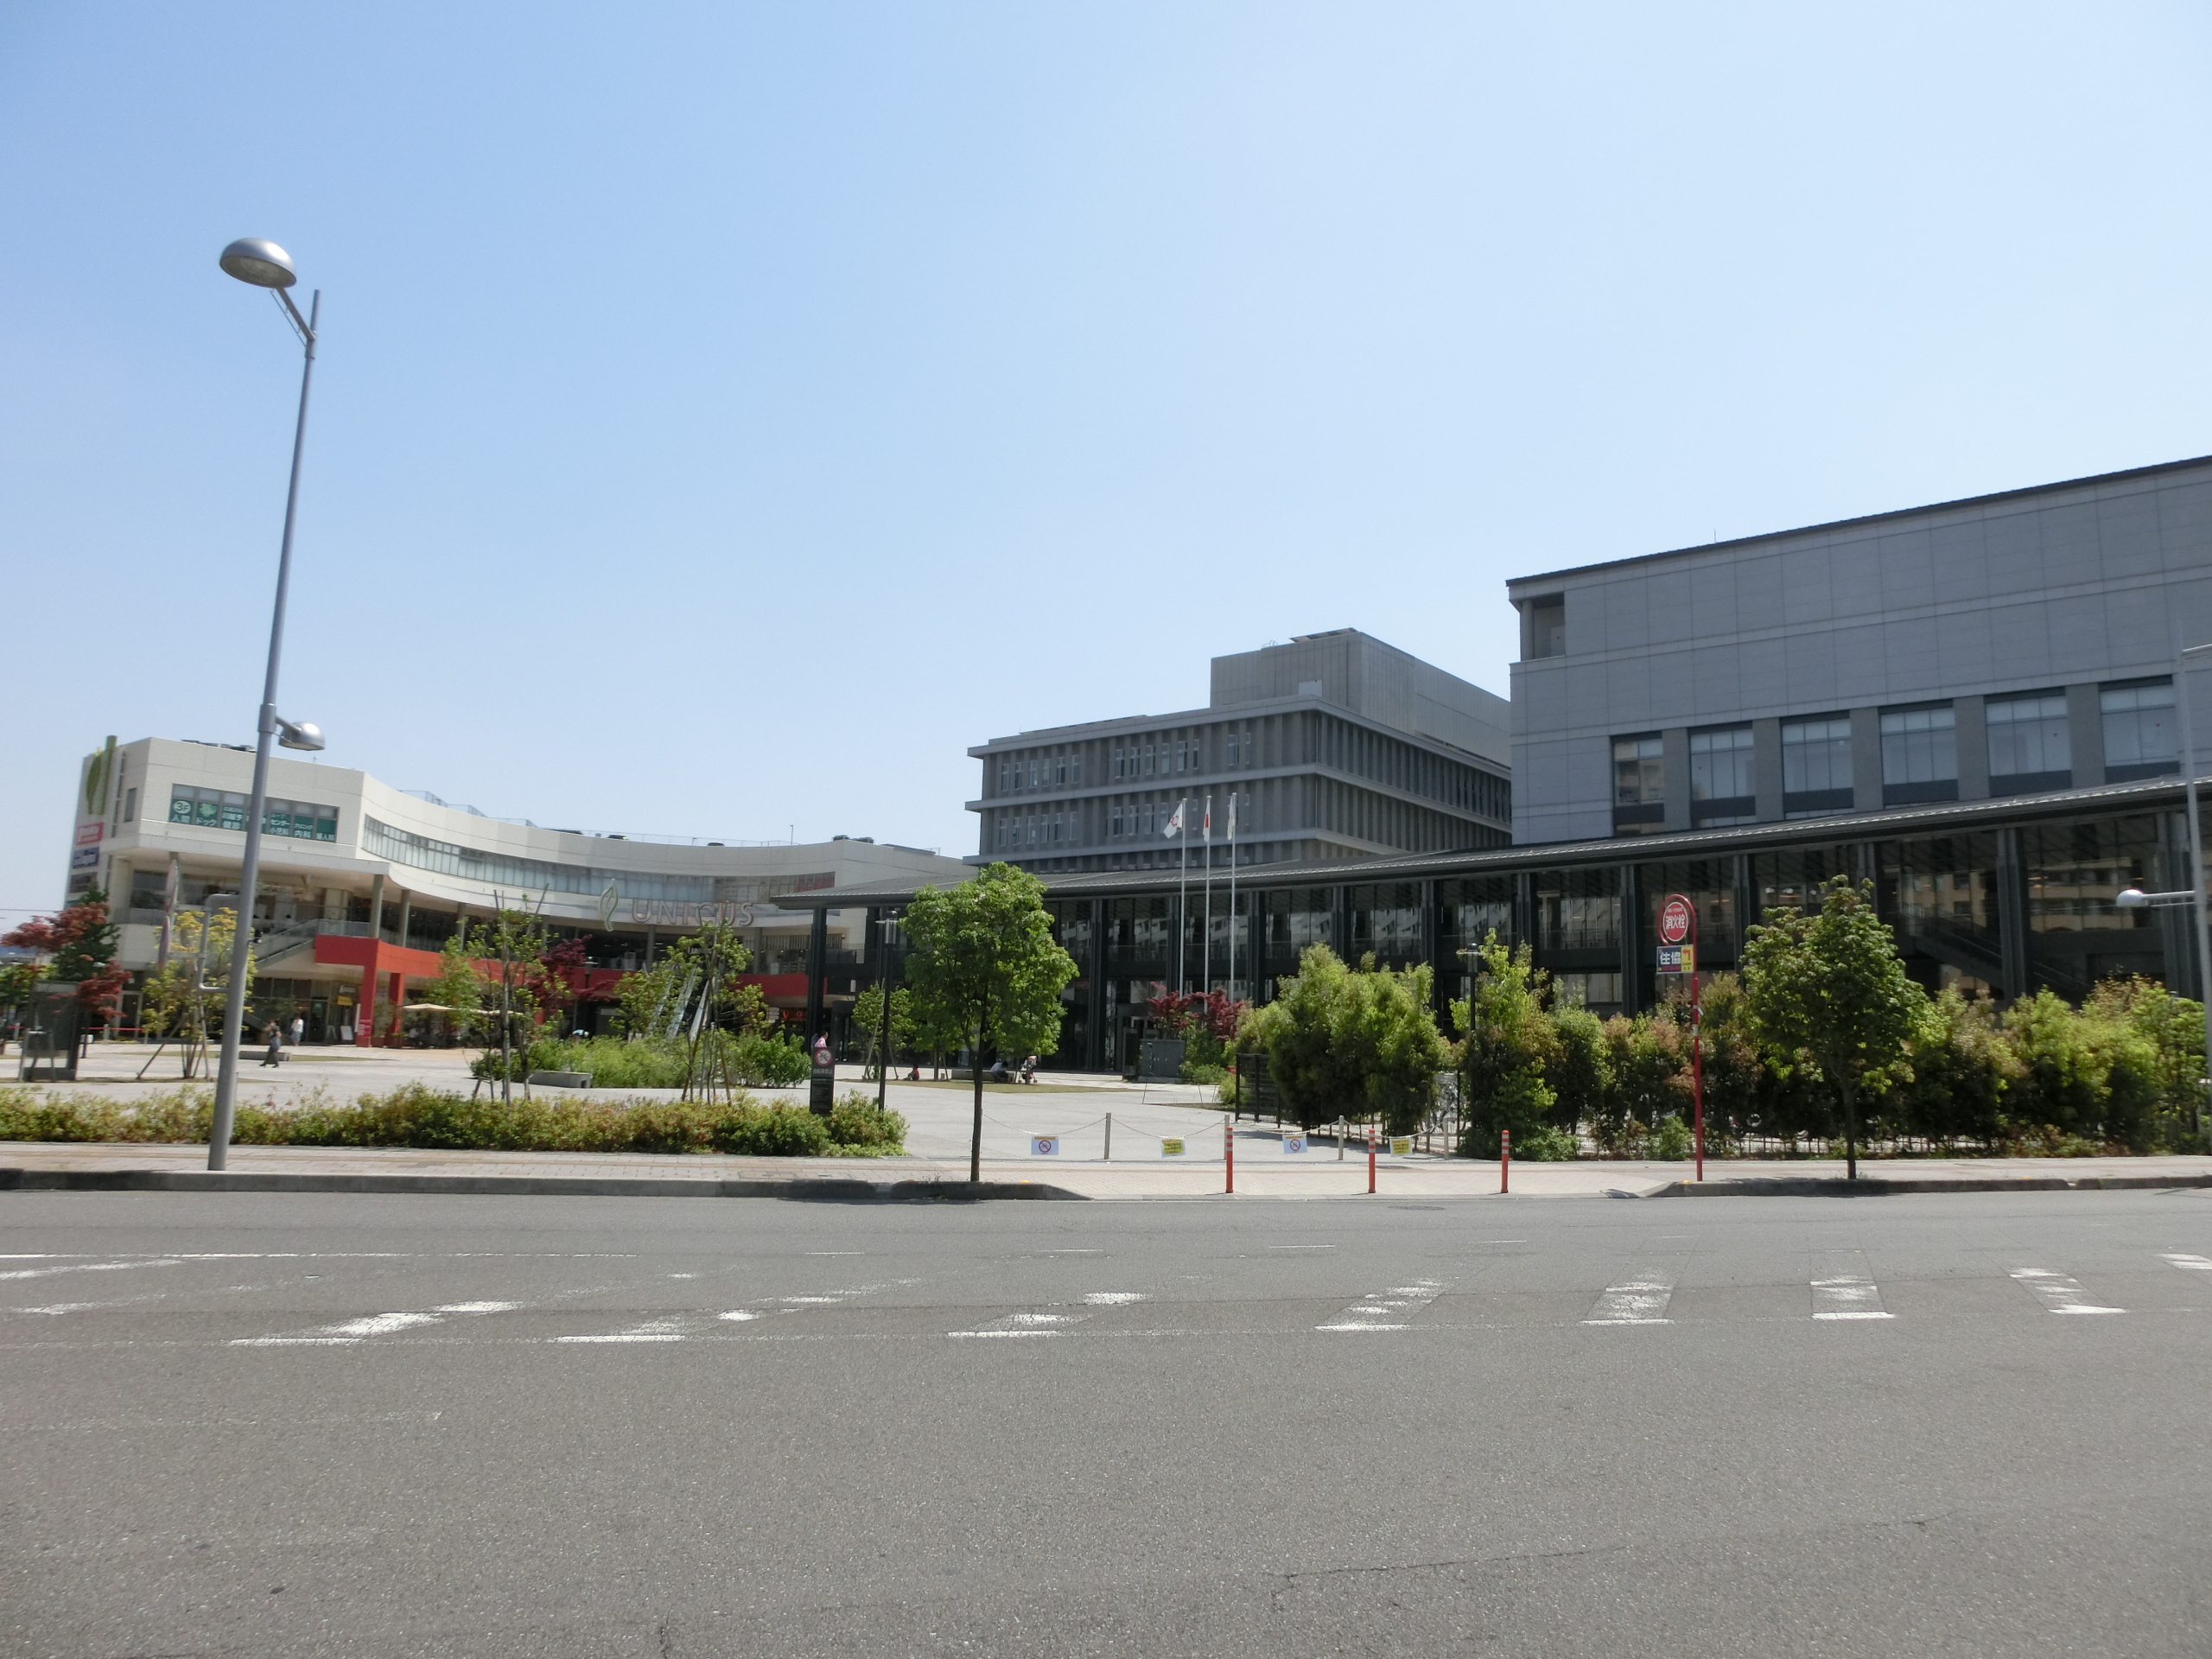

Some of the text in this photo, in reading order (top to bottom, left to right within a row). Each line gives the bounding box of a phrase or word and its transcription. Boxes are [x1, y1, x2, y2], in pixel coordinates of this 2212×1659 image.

[632, 898, 753, 926] UNICUS
[1665, 914, 1686, 930] 消火栓
